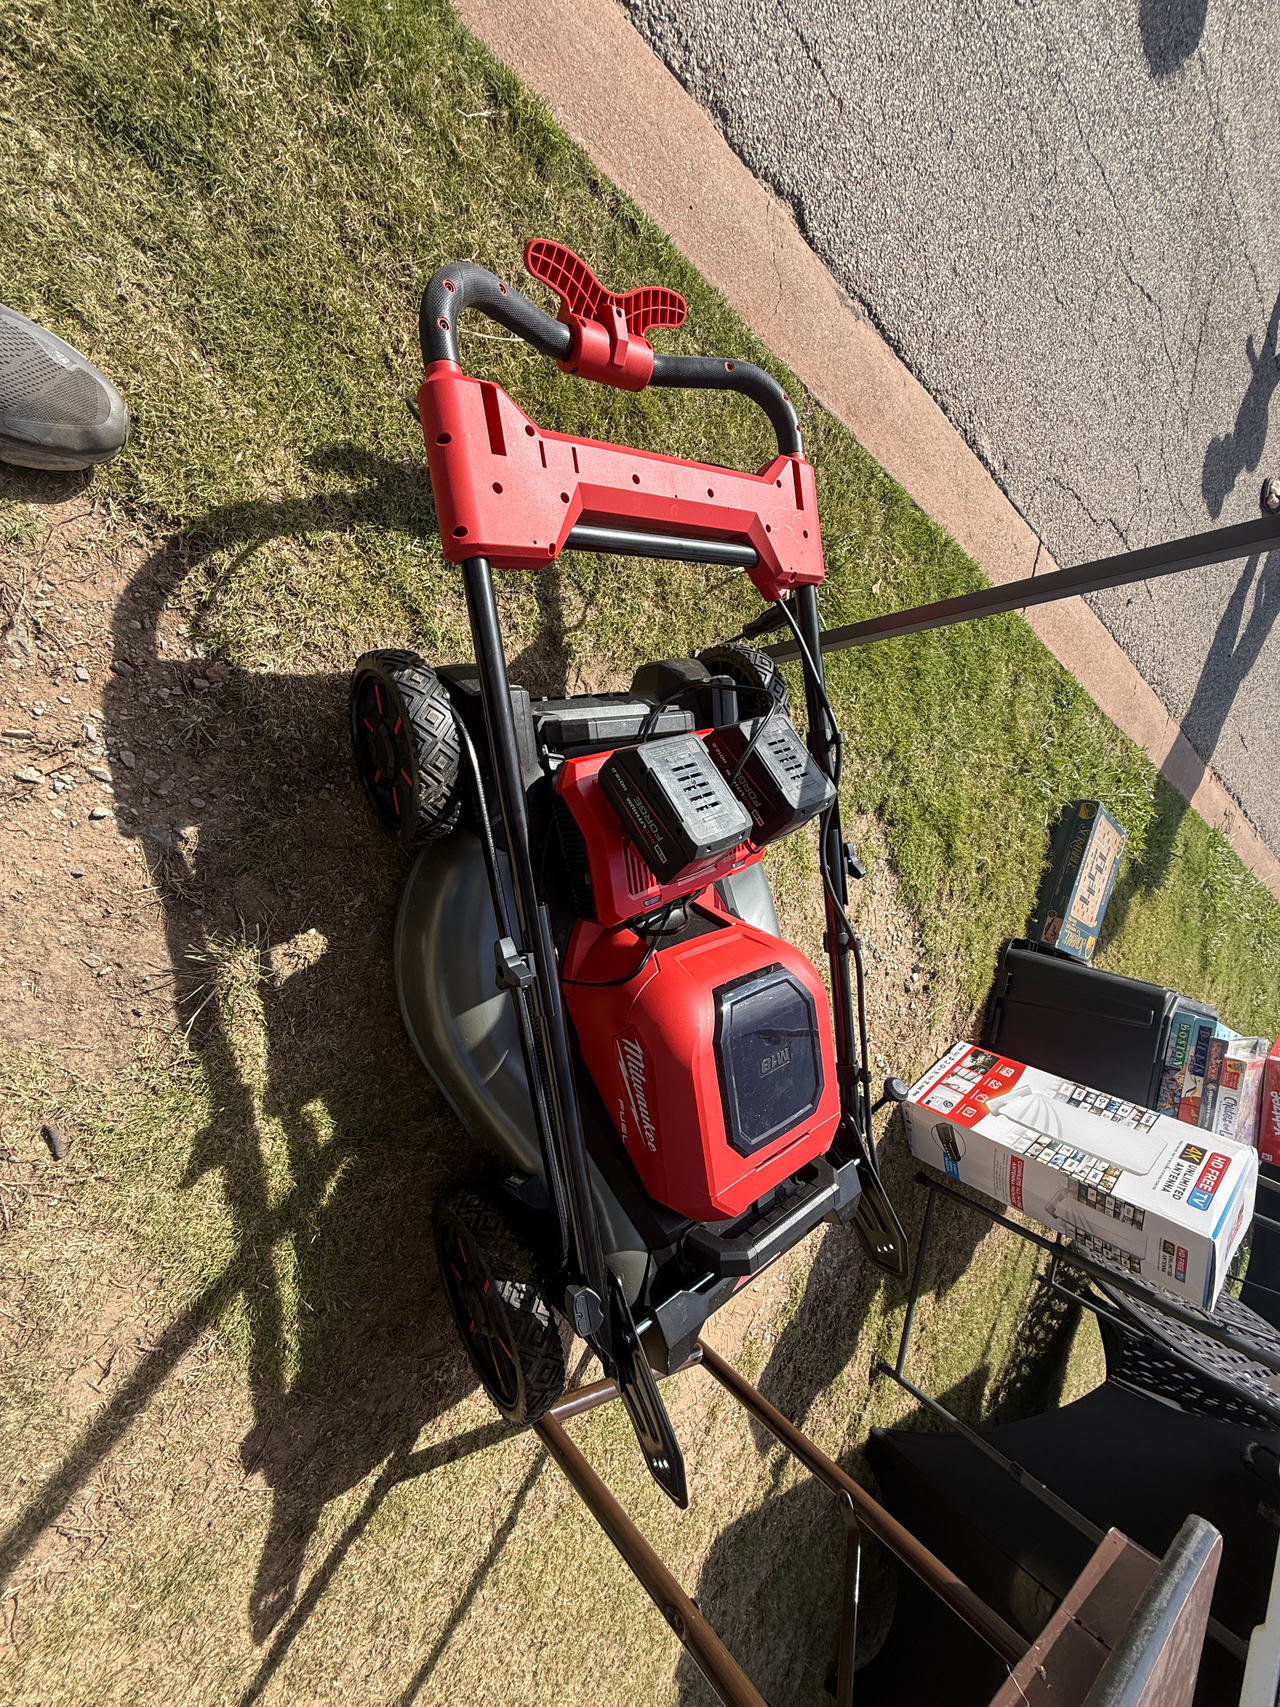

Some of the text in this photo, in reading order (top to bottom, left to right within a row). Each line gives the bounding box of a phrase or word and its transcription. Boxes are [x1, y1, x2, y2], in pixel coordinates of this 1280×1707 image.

[737, 773, 763, 808] FORG
[633, 796, 664, 842] FORGE
[1173, 1023, 1191, 1069] BOSTON
[621, 1037, 657, 1152] Milwaukee
[1222, 1096, 1238, 1123] Chutes
[618, 1098, 628, 1144] FUEL
[1160, 1162, 1181, 1193] ANTENNA
[1172, 1145, 1203, 1201] 4K UNLIMITED
[1191, 1154, 1227, 1208] HD FREE TV
